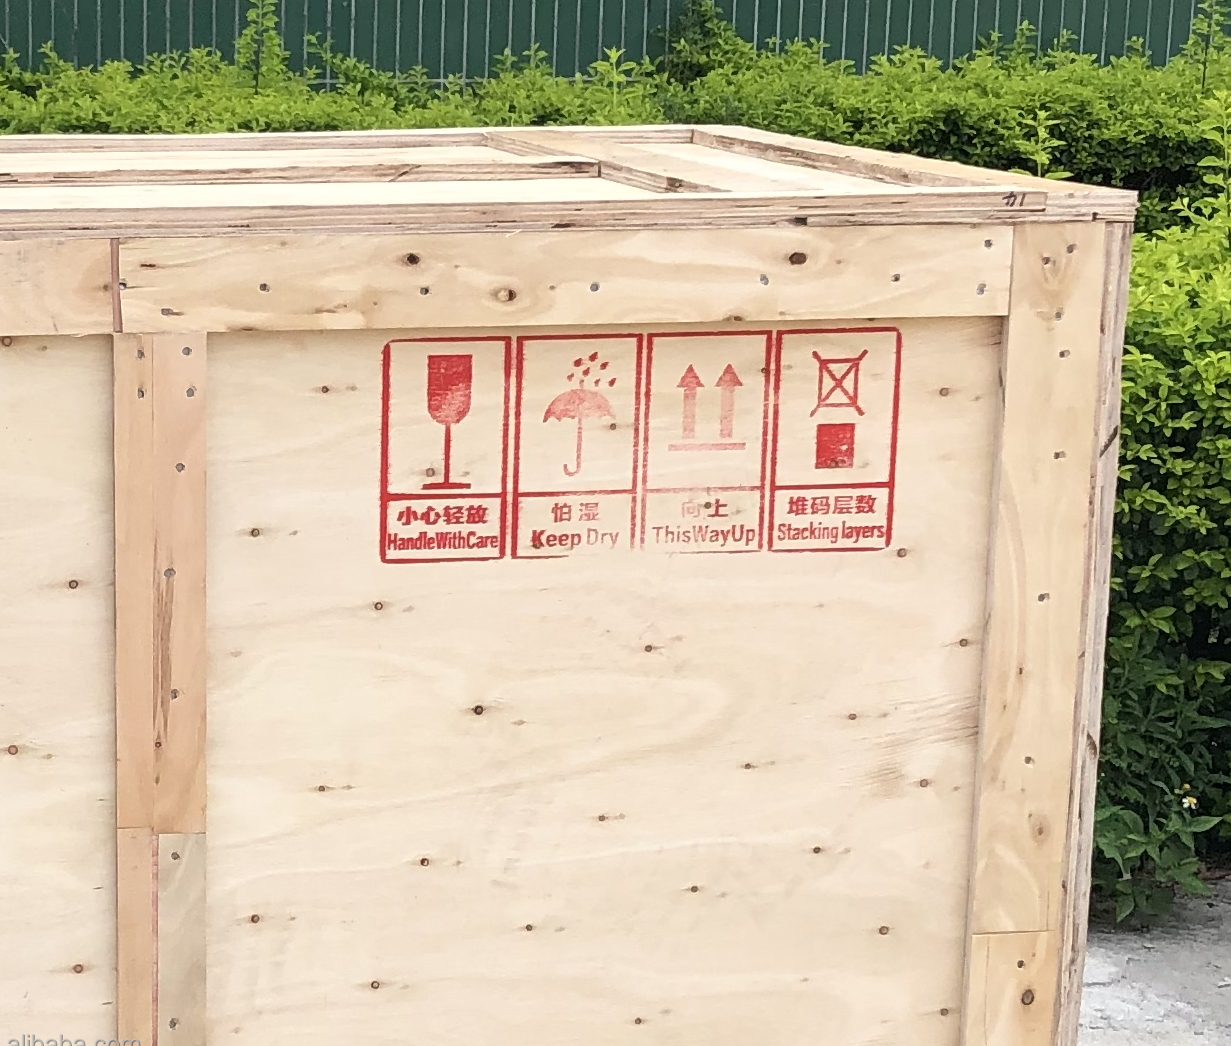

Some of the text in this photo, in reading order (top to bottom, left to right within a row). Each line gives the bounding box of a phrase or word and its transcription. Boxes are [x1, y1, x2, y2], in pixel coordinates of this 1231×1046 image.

[396, 505, 489, 526] 小心轻放
[681, 498, 729, 518] 向上
[786, 494, 877, 516] 堆码层数
[387, 530, 499, 551] HandleWithCare
[530, 528, 620, 550] Keep Dry
[777, 520, 885, 543] Stacking layers
